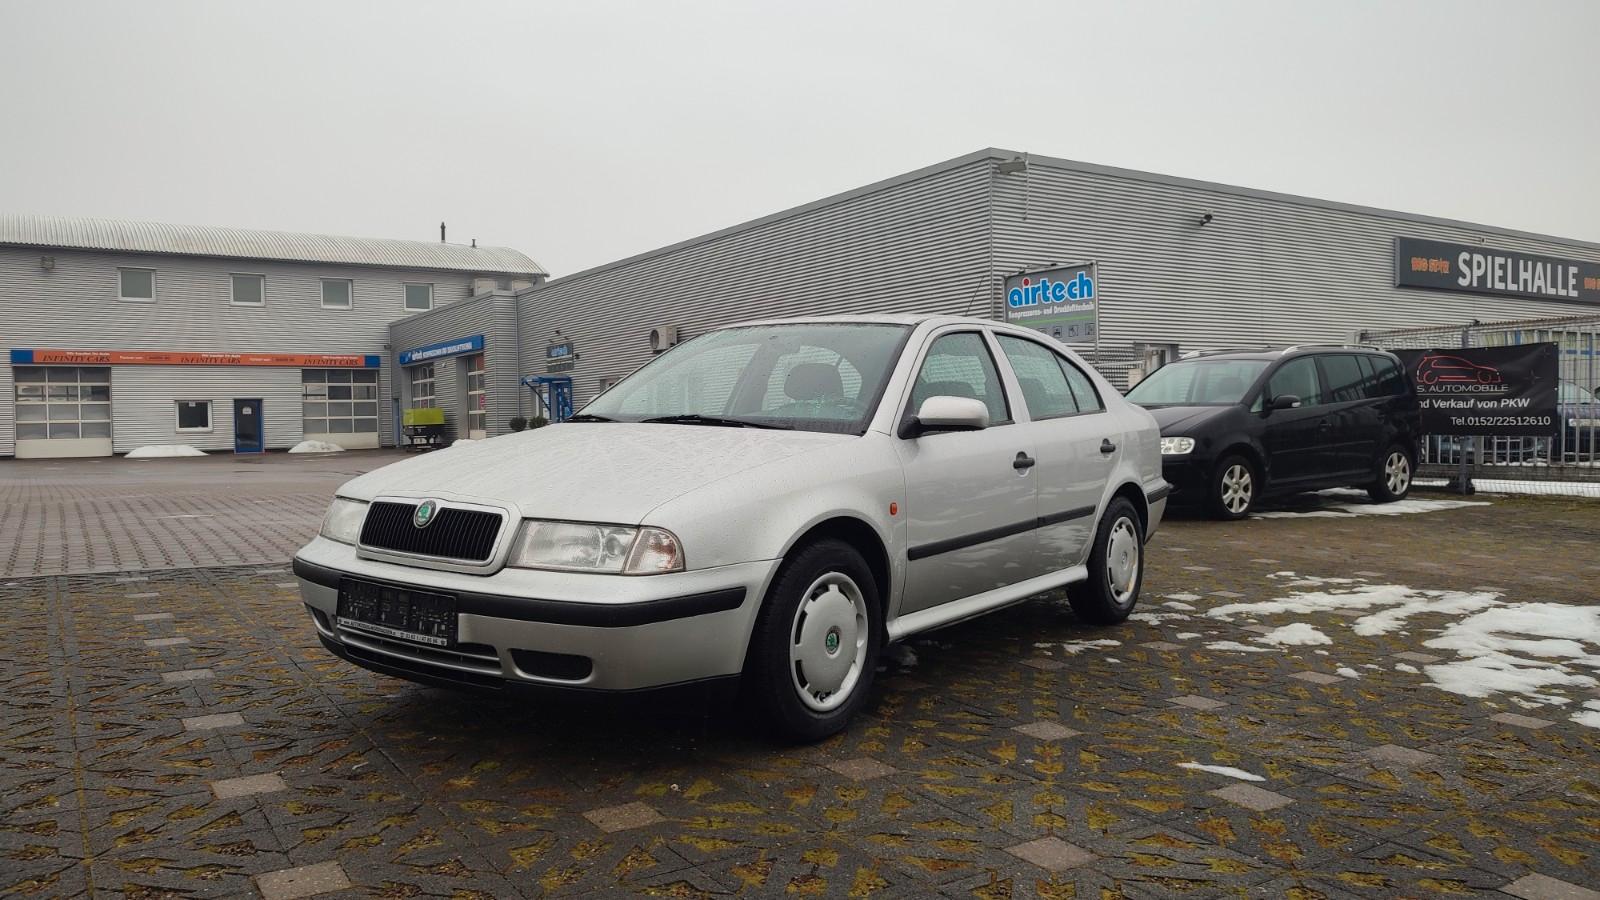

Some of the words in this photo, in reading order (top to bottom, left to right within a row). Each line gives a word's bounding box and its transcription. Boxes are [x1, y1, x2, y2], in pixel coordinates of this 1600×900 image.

[1457, 251, 1579, 297] SPIELHALLE
[1008, 271, 1094, 308] airtech
[42, 354, 84, 362] INFINITY
[86, 355, 110, 363] CARS
[181, 356, 218, 364] INFINITY
[1428, 383, 1509, 393] AUTOMOBILE
[1432, 398, 1476, 409] Verkauf
[1476, 399, 1498, 409] von
[1500, 397, 1531, 408] PKW
[1451, 415, 1551, 426] Tel.0152/22512610
